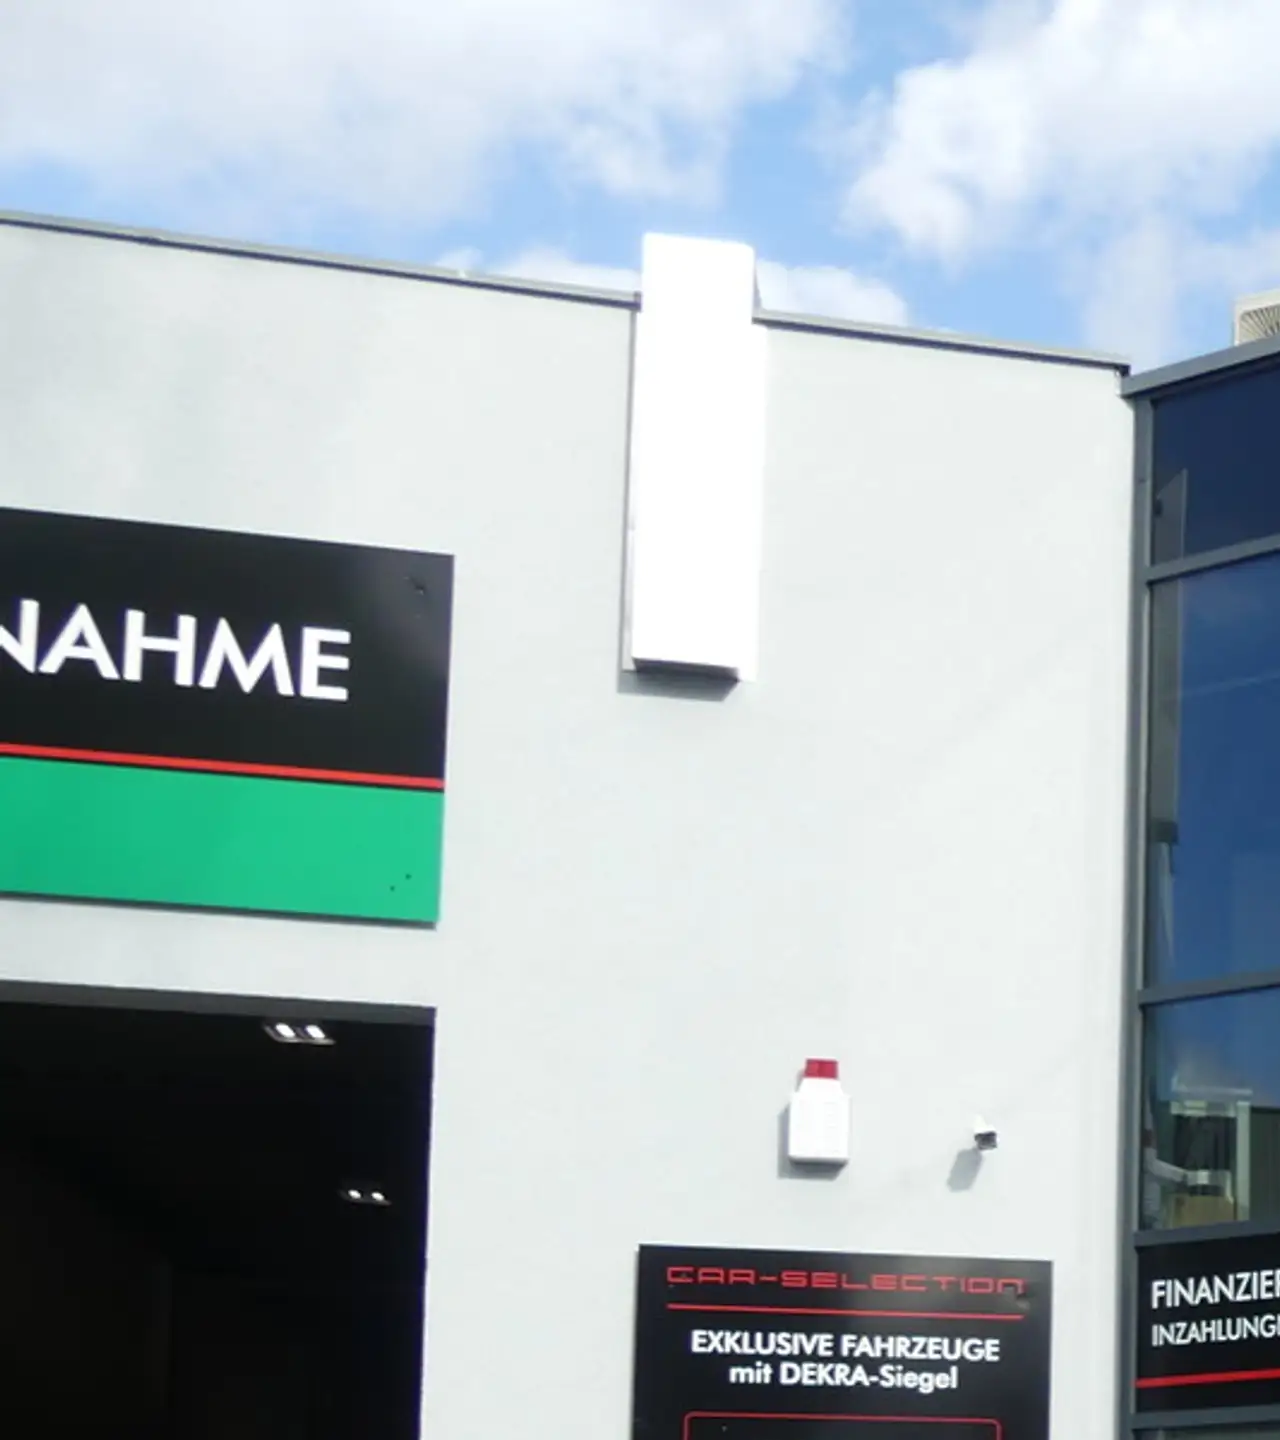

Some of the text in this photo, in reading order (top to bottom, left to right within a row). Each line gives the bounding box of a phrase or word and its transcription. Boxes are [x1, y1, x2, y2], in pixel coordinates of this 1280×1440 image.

[666, 1265, 1026, 1294] CAR-SELECTION
[690, 1329, 1001, 1362] EXKLUSIVE FAHRZEUGE
[729, 1360, 959, 1395] mit DEKRA-Siegel
